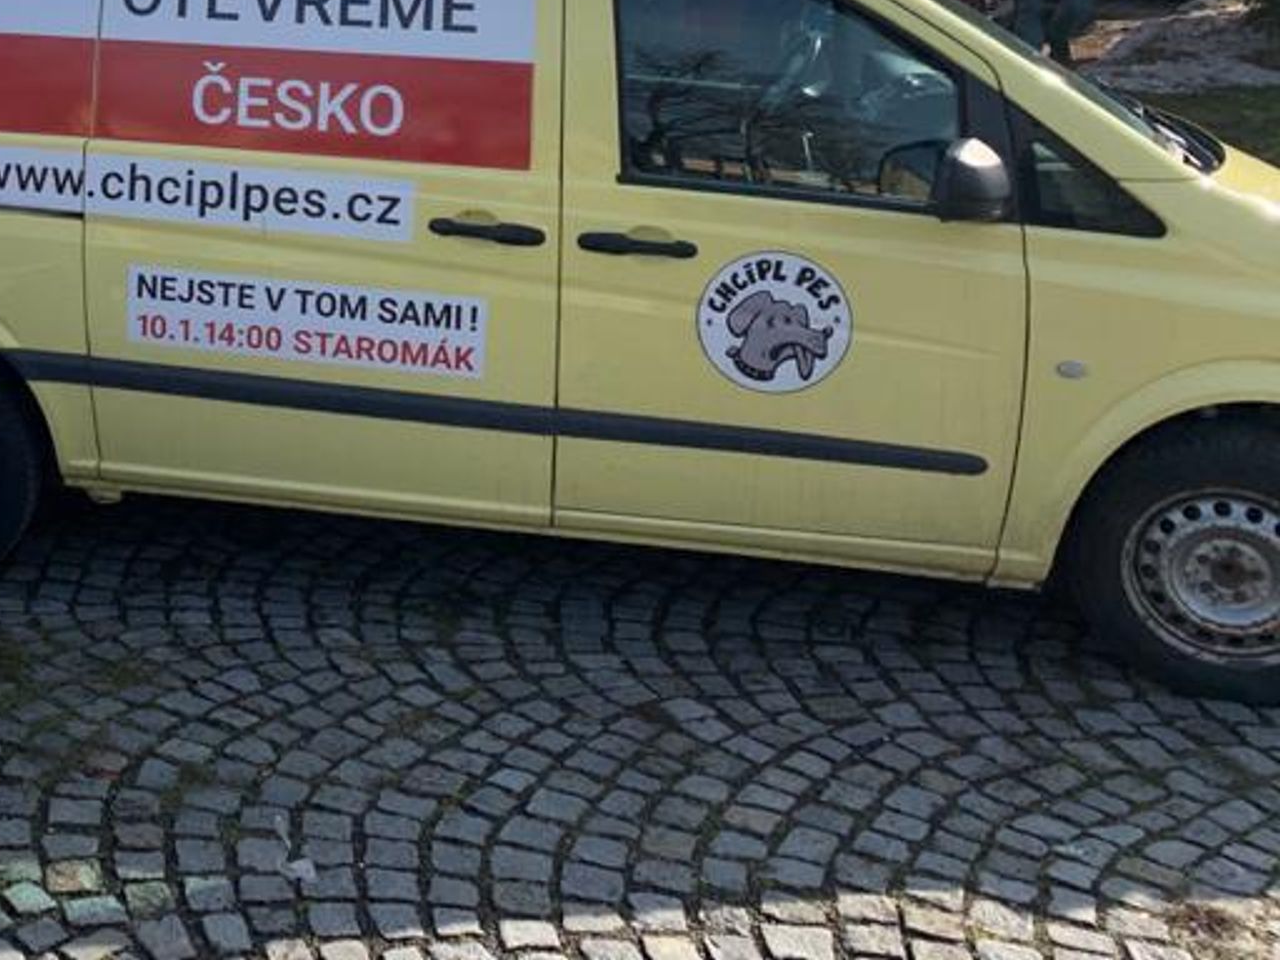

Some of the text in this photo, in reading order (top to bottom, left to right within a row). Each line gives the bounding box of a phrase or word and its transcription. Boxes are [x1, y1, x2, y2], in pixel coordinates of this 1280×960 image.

[192, 60, 405, 137] ČESKO
[136, 273, 257, 310] NEJSTE
[265, 286, 287, 313] V
[295, 288, 368, 322] TOM
[794, 266, 841, 311] PES
[292, 329, 476, 373] STAROMÁK
